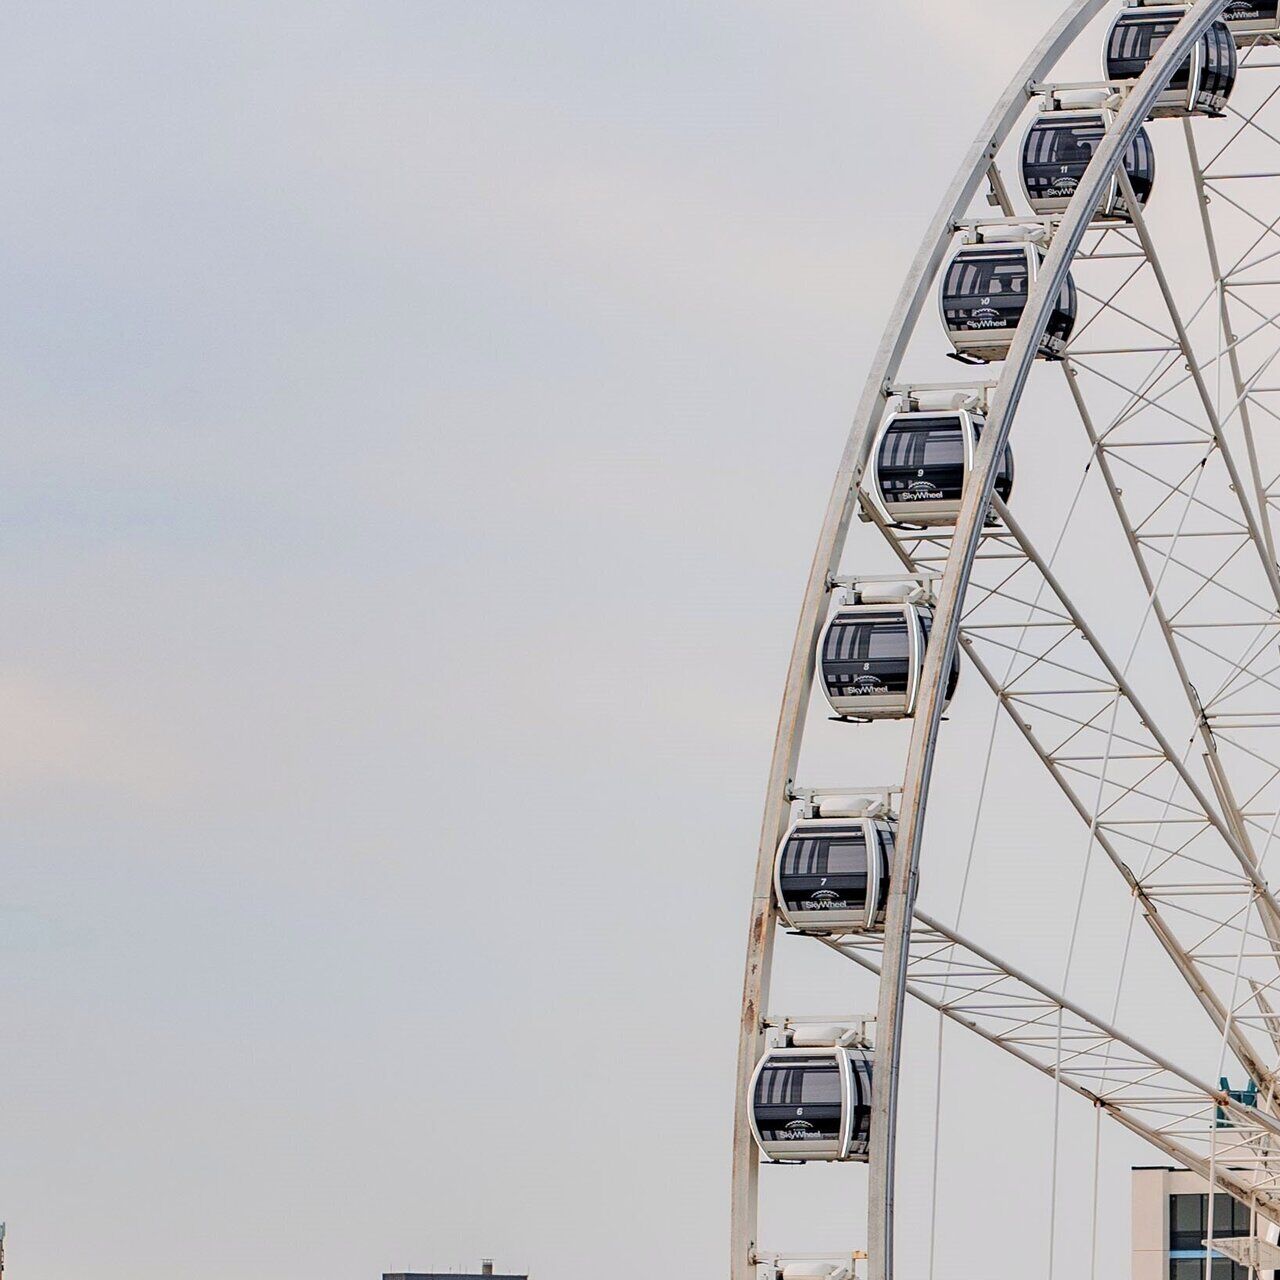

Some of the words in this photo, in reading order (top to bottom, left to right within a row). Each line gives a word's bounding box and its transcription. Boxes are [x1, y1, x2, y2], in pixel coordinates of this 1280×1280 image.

[967, 320, 1007, 328] SkyWheel
[902, 492, 943, 500] SkyWheel
[847, 686, 888, 694] SkyWheel
[805, 901, 846, 909] SkyWheel
[780, 1131, 821, 1139] SkyWheel
